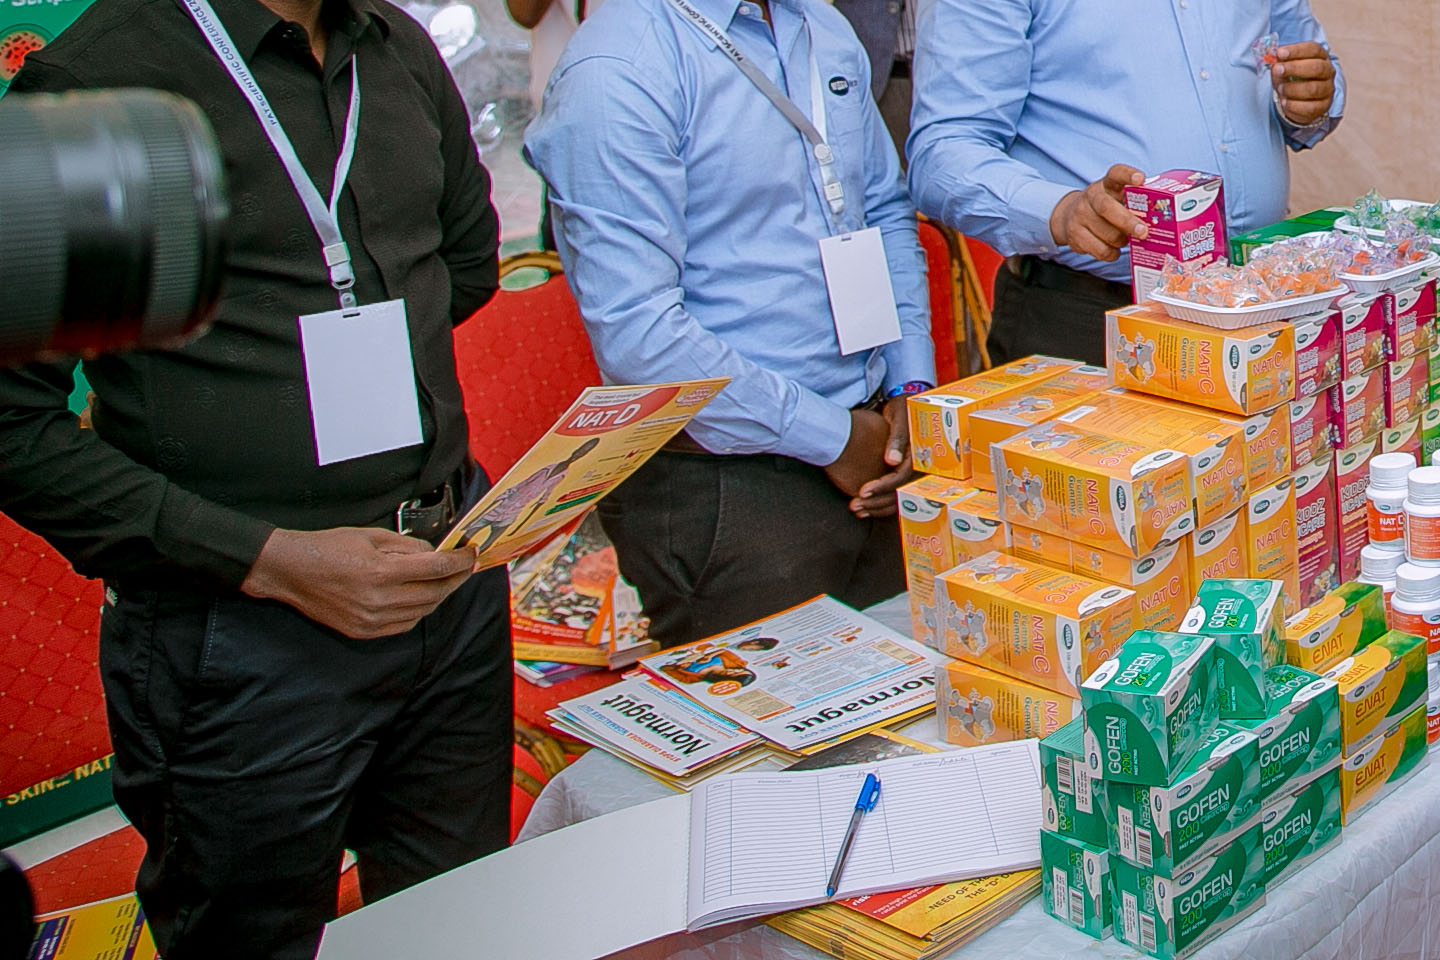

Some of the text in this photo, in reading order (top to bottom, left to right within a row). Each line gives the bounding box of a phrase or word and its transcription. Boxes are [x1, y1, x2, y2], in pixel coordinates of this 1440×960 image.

[193, 6, 235, 61] CONFERENCE
[231, 60, 266, 107] SCIENTIFIC
[1180, 222, 1214, 247] KIDDZ
[1199, 340, 1215, 394] NAT C
[1252, 357, 1274, 377] NAT
[1272, 351, 1284, 368] C
[567, 409, 619, 430] NAT
[613, 403, 641, 425] D
[930, 412, 947, 458] NAT C
[1248, 429, 1278, 455] NAT C
[1202, 458, 1236, 489] NAT C
[1085, 479, 1105, 536] NAT C
[1151, 508, 1168, 529] C
[1380, 517, 1397, 525] NAT
[906, 533, 943, 557] NAT C
[1255, 519, 1290, 551] NAT C
[1202, 547, 1240, 580] NAT C
[1140, 576, 1180, 613] NAT C
[1208, 598, 1236, 629] GOFEN
[1031, 615, 1050, 674] NAT C
[1312, 633, 1344, 665] ENAT
[1114, 652, 1157, 686] GOFEN
[784, 674, 935, 732] Normagut
[1268, 675, 1310, 700] GOFE
[1355, 686, 1387, 718] ENAT
[600, 694, 711, 756] Normagut
[1170, 688, 1201, 735] GOFEN
[1427, 718, 1440, 728] NAT
[1105, 715, 1122, 775] GOFEN
[1259, 727, 1309, 768] GOFEN
[1121, 751, 1132, 775] 200
[1261, 760, 1281, 781] 200
[1355, 753, 1386, 786] ENAT
[1142, 789, 1150, 828] GOFEN
[1176, 783, 1230, 828] GOFEN
[1179, 802, 1230, 842] 200 clearcap
[1263, 809, 1312, 851] GOFEN
[1265, 843, 1284, 865] 200
[956, 885, 969, 895] OF
[965, 887, 985, 900] THE
[1180, 869, 1232, 914] GOFEN
[1182, 907, 1202, 929] 200
